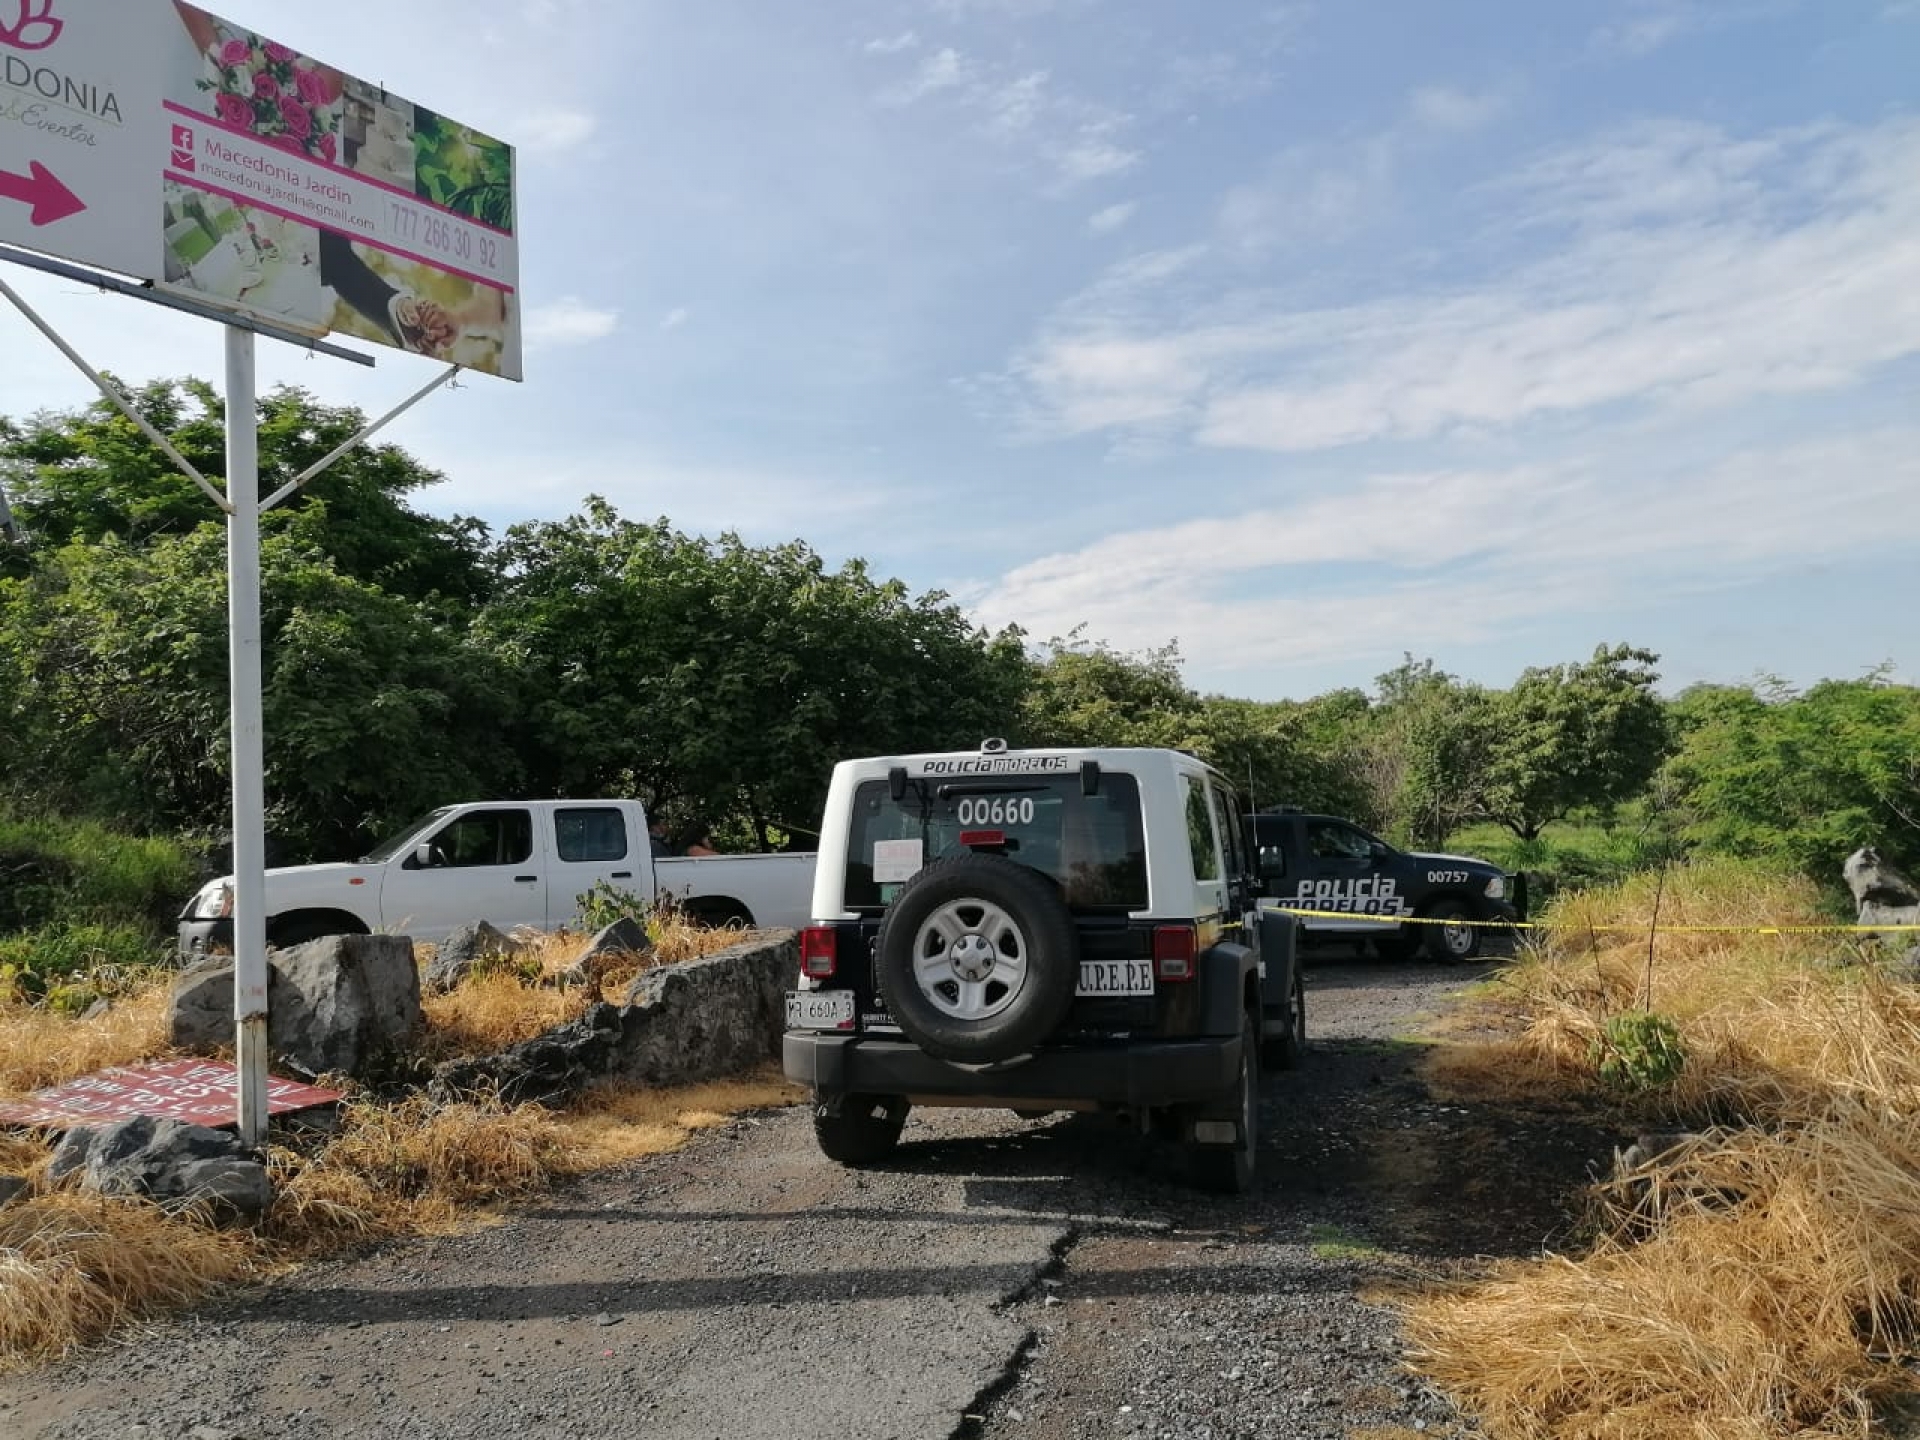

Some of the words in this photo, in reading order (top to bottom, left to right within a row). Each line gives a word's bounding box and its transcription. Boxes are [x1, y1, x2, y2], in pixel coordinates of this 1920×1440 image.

[0, 53, 122, 123] DONIA
[21, 103, 97, 146] Eventos
[205, 138, 300, 187] Macedonia
[391, 203, 418, 240] 777
[424, 215, 450, 252] 266
[454, 227, 470, 259] 30
[480, 236, 496, 268] 92
[957, 797, 1035, 825] 00660
[1427, 870, 1470, 883] 00757
